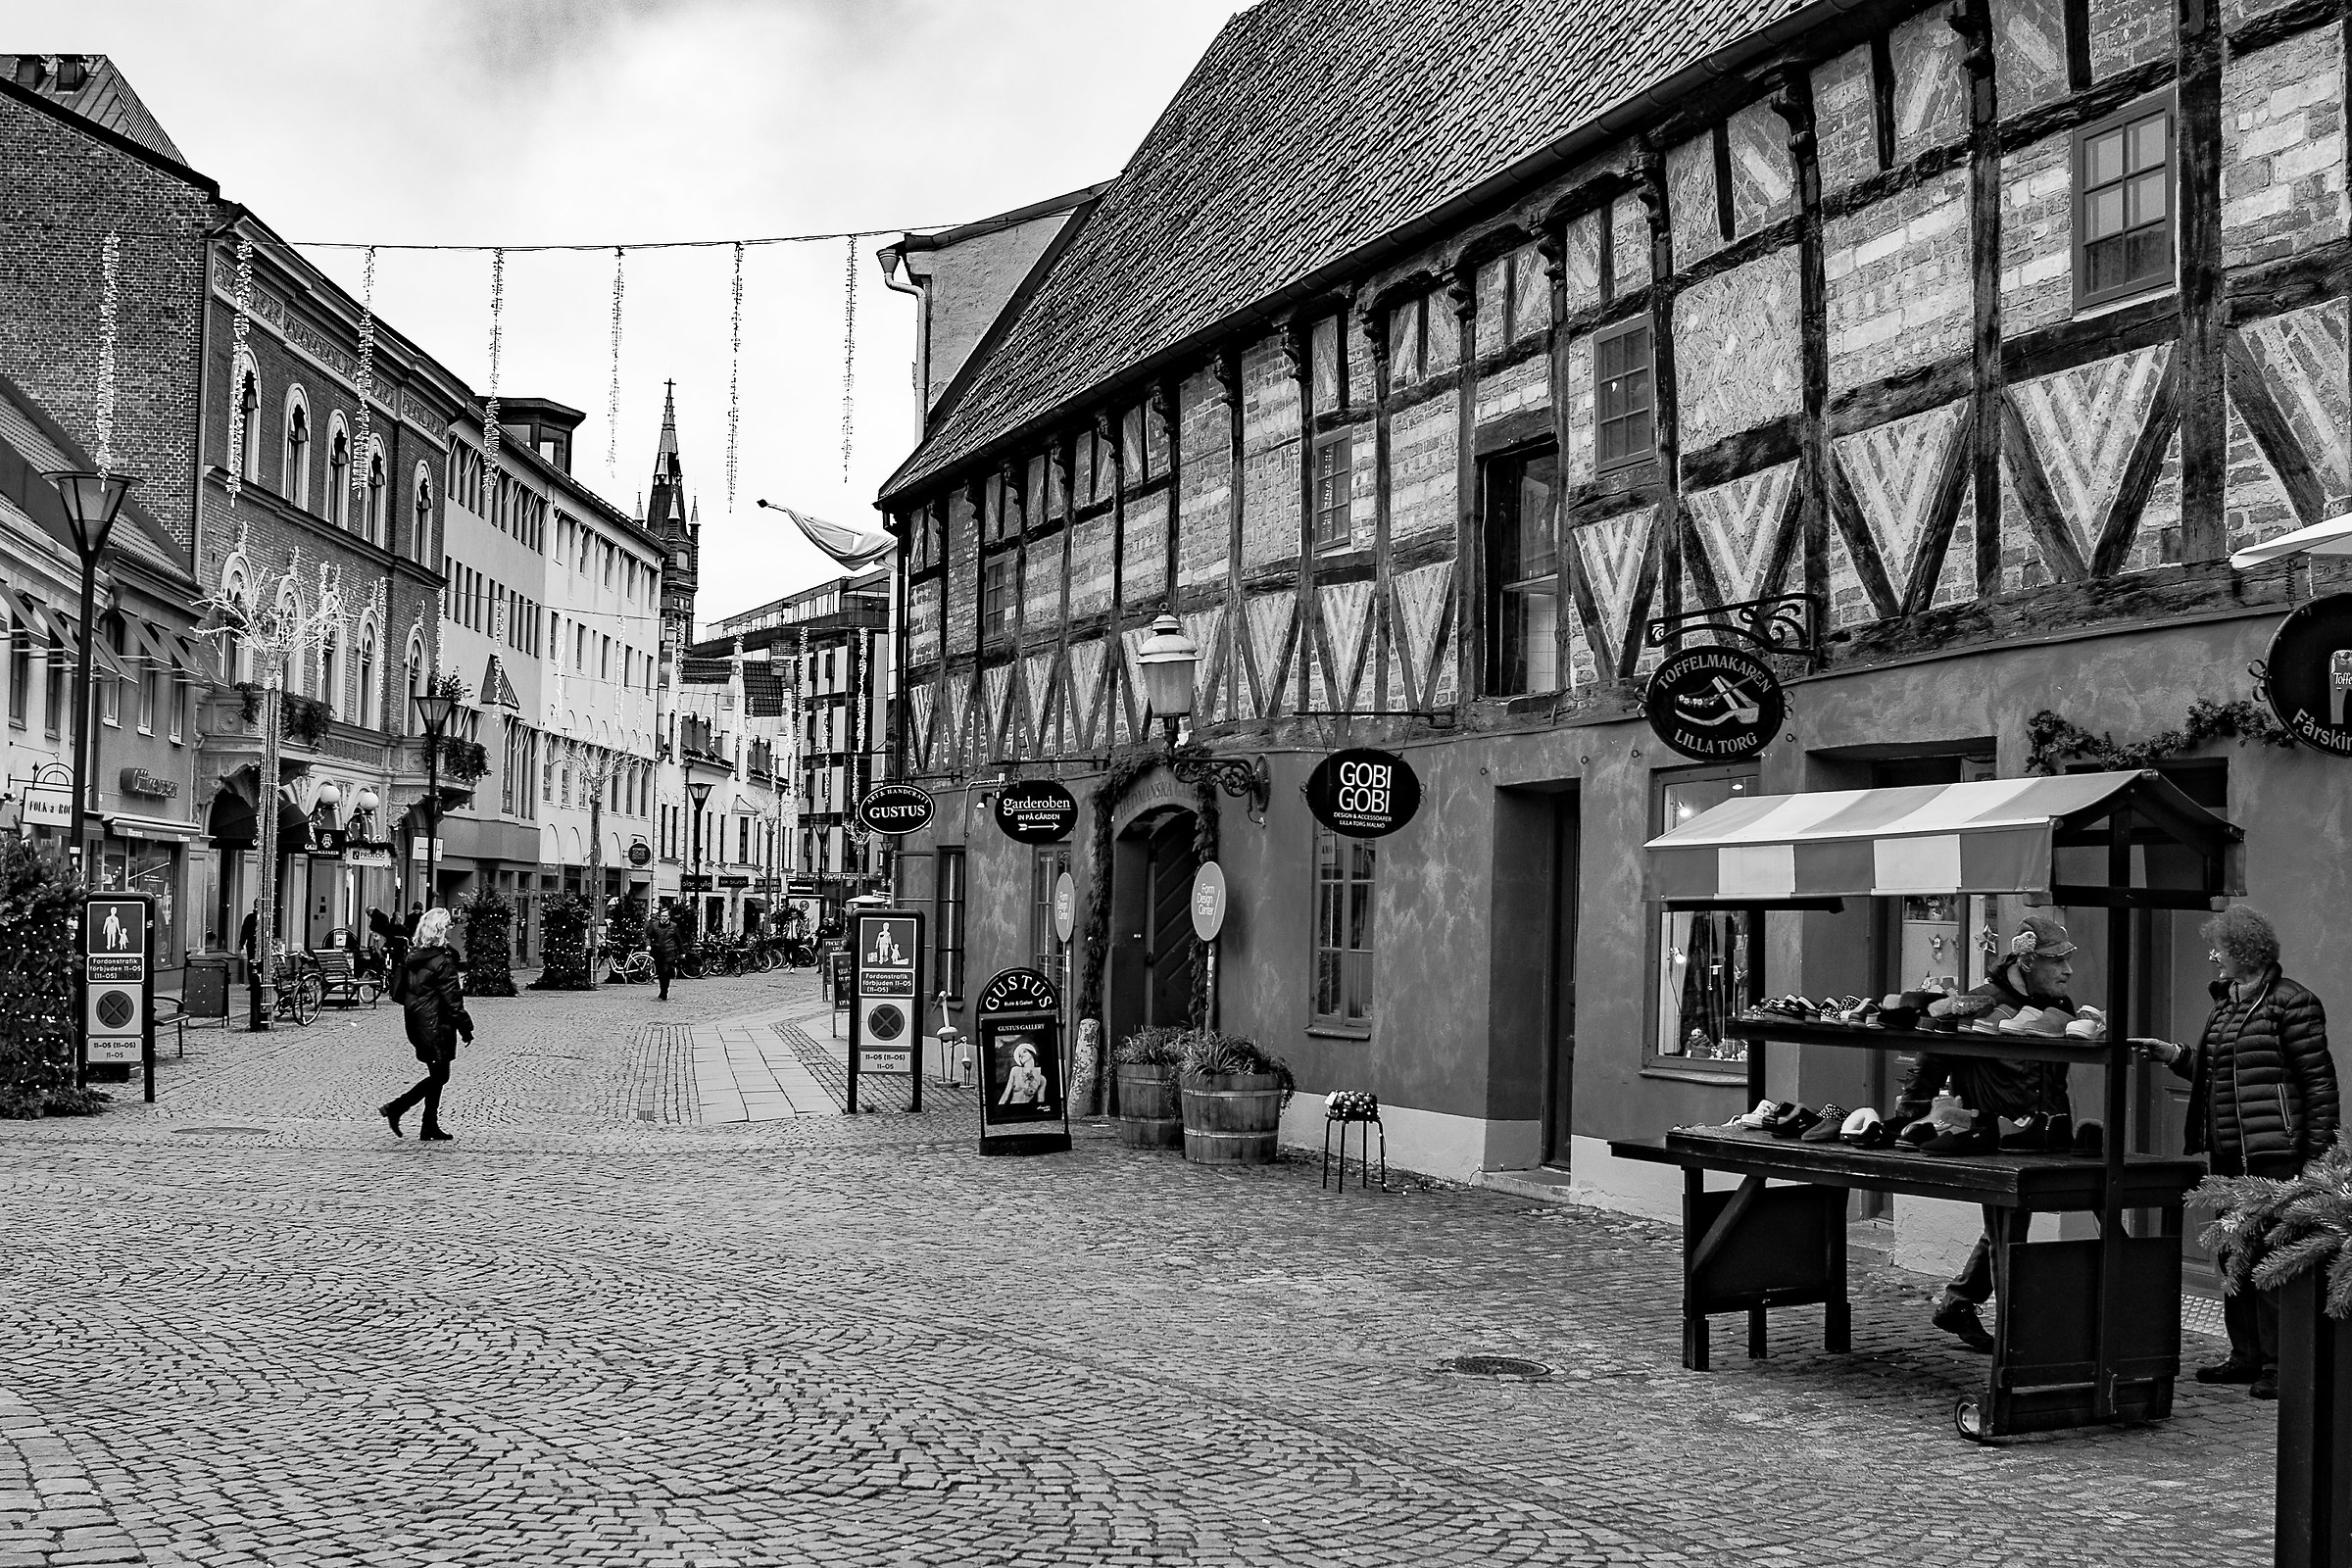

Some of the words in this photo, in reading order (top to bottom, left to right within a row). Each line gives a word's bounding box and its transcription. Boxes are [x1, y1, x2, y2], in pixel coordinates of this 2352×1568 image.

[1656, 654, 1772, 693] TOFFELMAKAREN
[1674, 728, 1714, 754] LILLA
[1717, 732, 1758, 754] TORG
[1340, 761, 1392, 789] GOBI
[887, 788, 930, 805] HANDCRAFT
[1339, 786, 1390, 813] GOBI
[29, 800, 47, 812] FOLK
[869, 805, 926, 819] GUSTUS
[1003, 796, 1071, 816] garderoben
[1201, 883, 1215, 894] Form
[1197, 892, 1213, 906] Design
[1198, 904, 1214, 915] Center
[985, 974, 1054, 1010] GUSTUS
